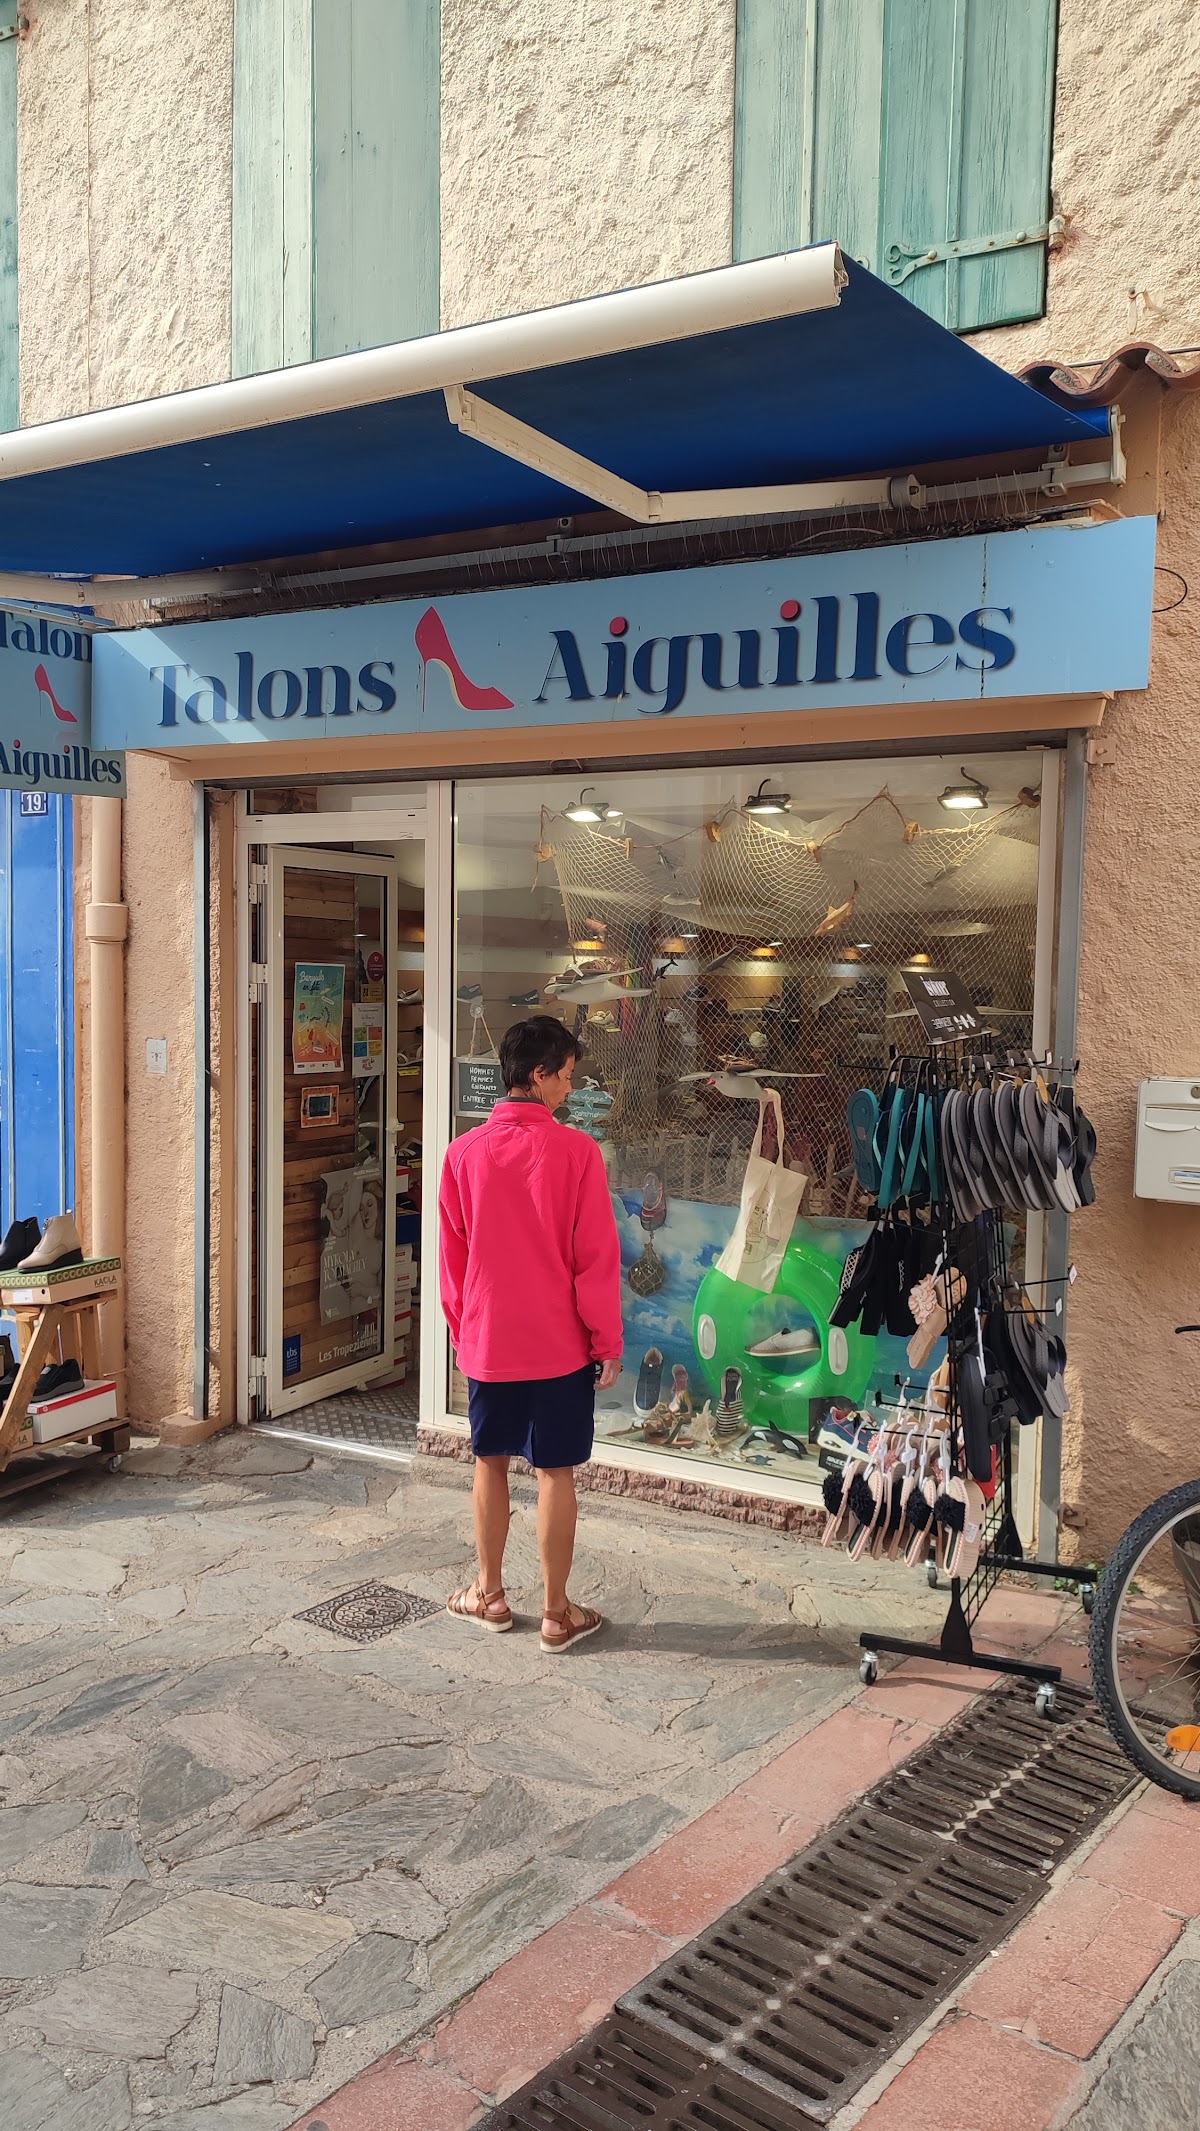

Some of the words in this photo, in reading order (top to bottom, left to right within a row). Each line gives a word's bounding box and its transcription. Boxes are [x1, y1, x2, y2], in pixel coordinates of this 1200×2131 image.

[149, 650, 397, 728] Talons
[532, 591, 1016, 715] Aiguilles
[26, 794, 42, 812] 19
[469, 1066, 495, 1076] HOMMES
[470, 1075, 494, 1083] FEMMES
[471, 1083, 497, 1091] ENFANTS
[318, 1348, 333, 1363] Les
